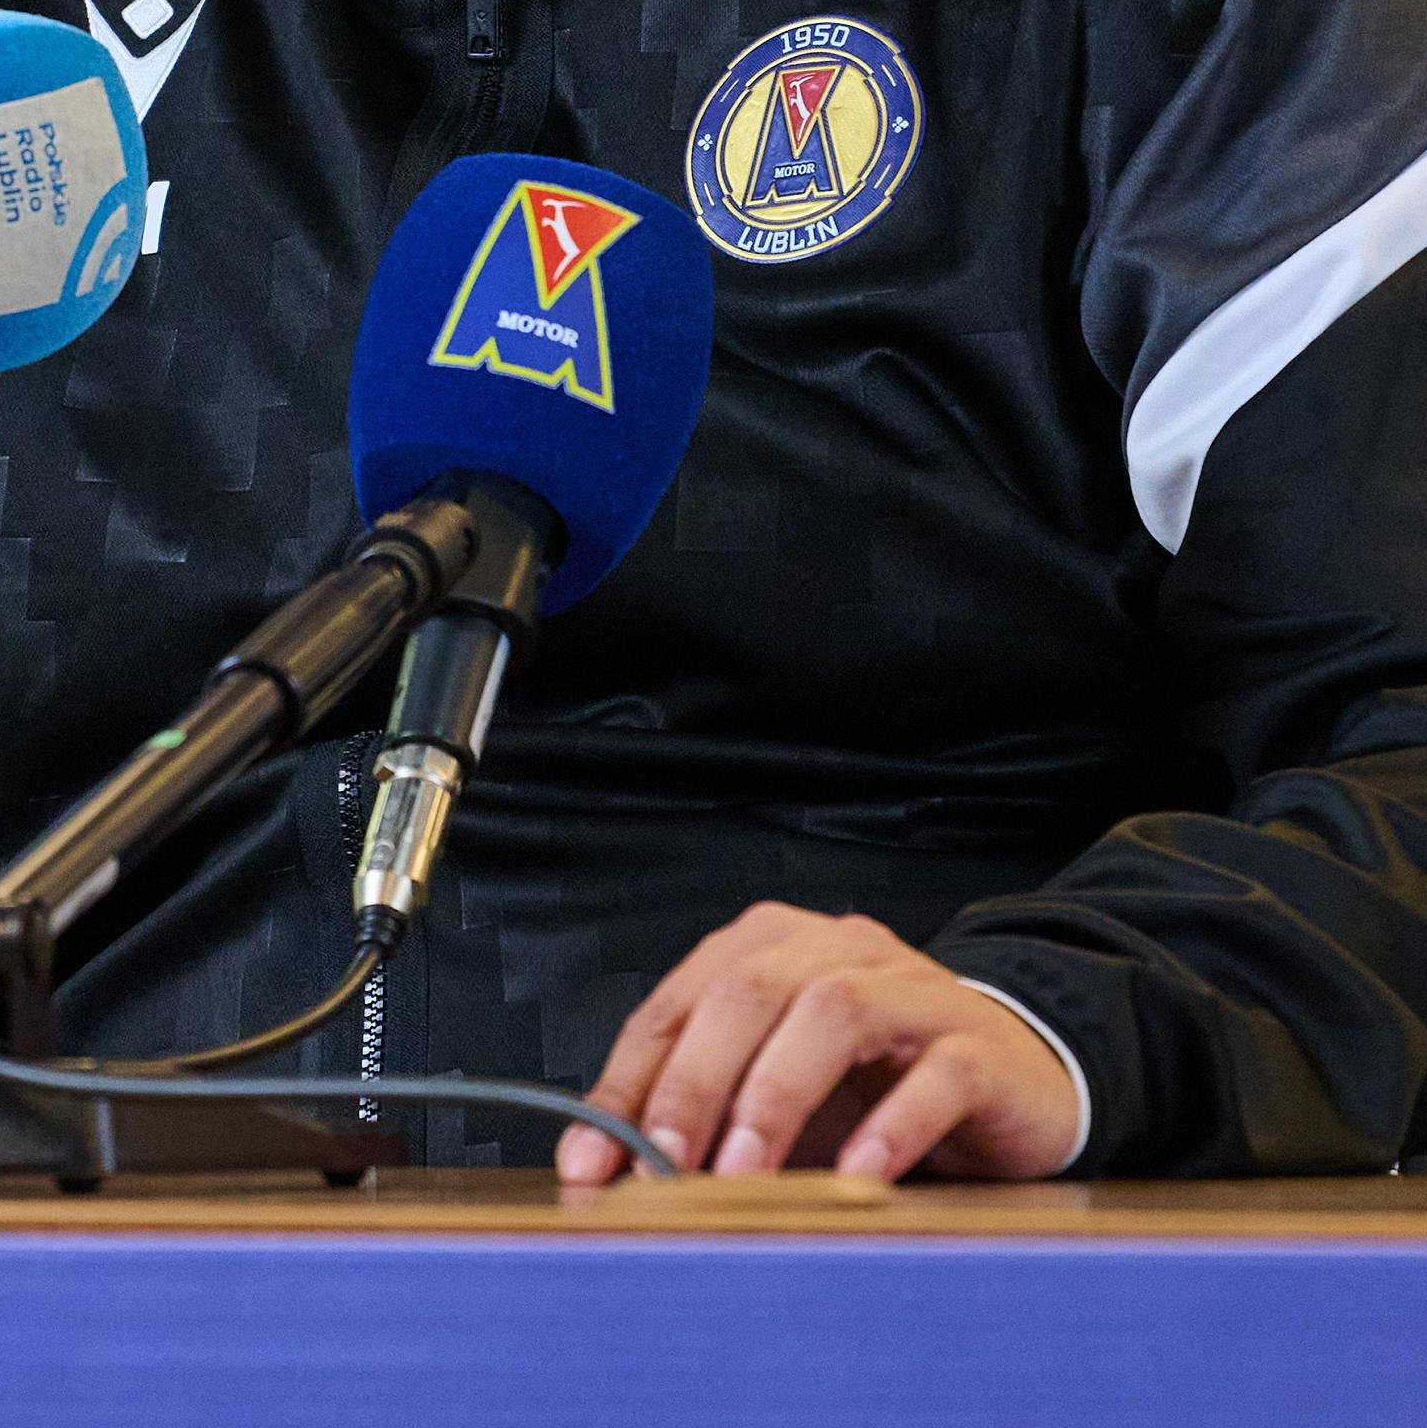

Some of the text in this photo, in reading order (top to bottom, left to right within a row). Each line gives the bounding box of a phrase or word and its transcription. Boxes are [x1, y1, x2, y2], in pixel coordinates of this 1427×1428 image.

[780, 24, 850, 54] 1950
[15, 128, 46, 212] Radio
[774, 163, 816, 179] MOTOR
[737, 216, 840, 254] LUBLIN
[496, 309, 580, 349] MOTOR
